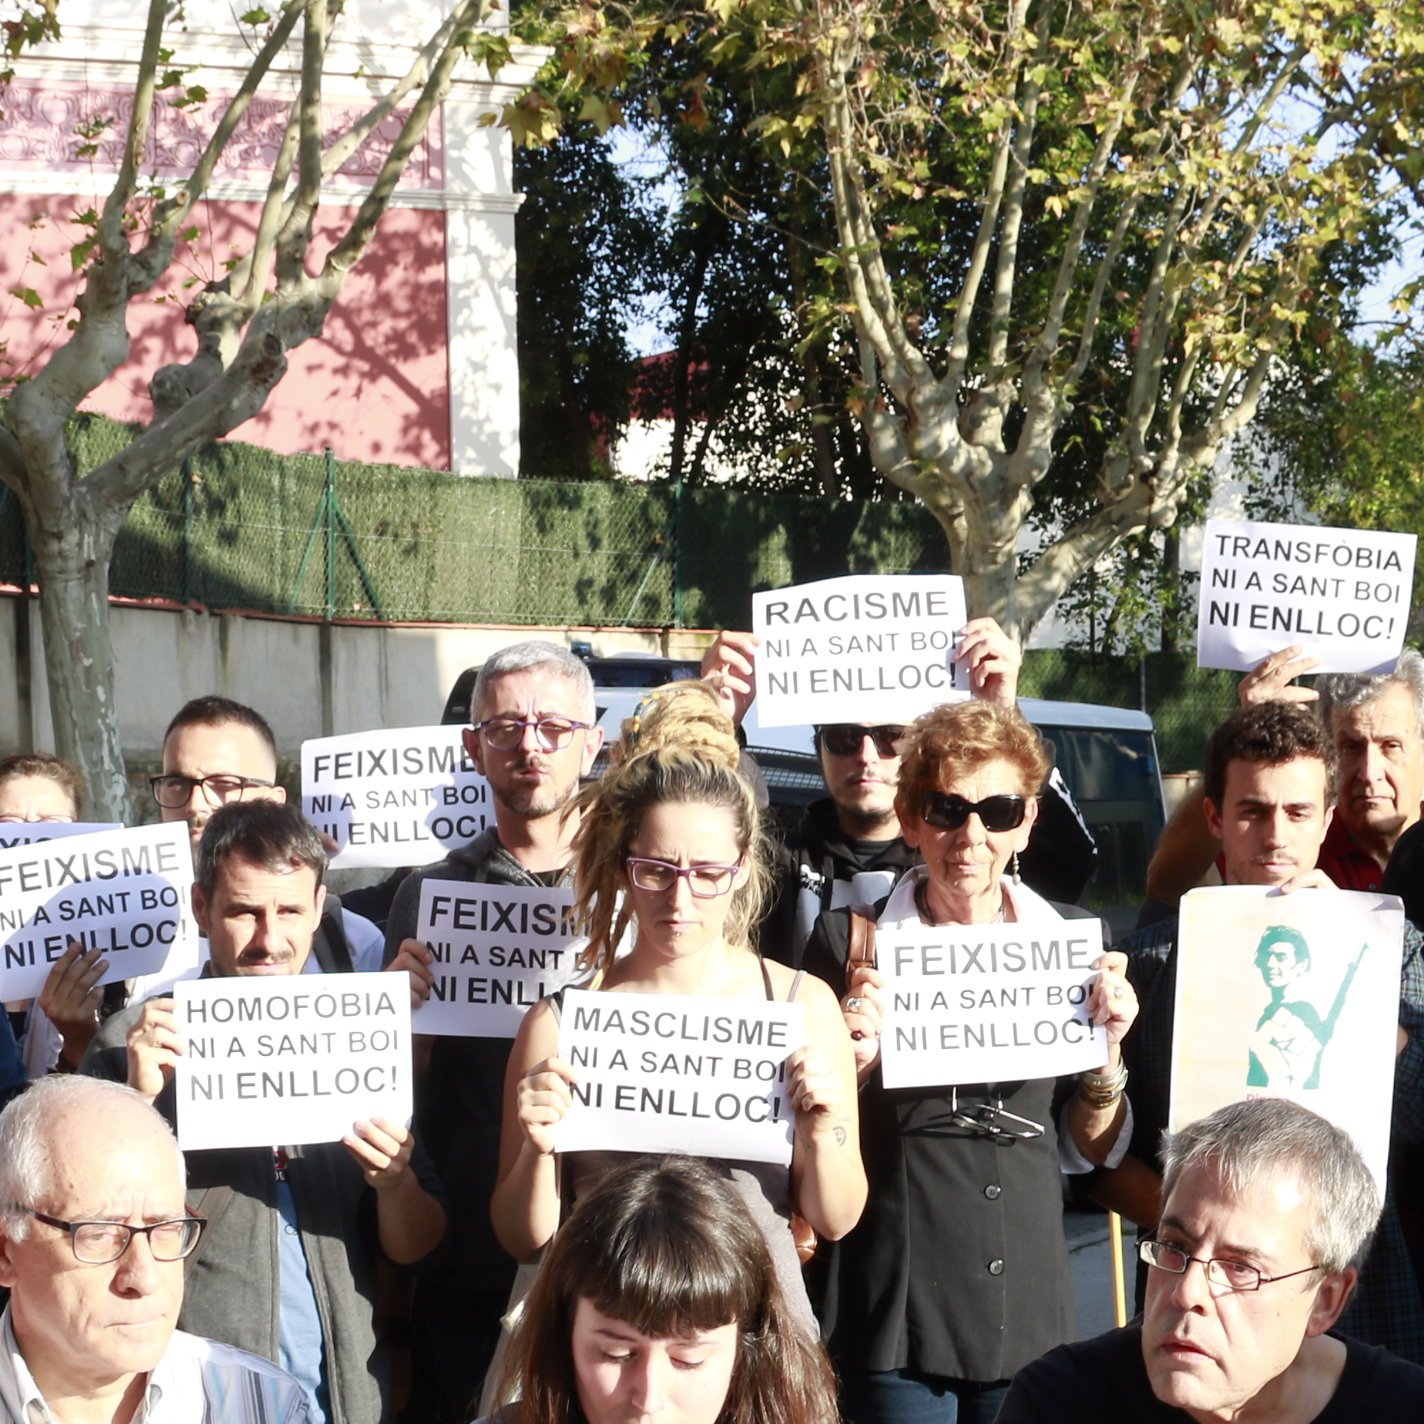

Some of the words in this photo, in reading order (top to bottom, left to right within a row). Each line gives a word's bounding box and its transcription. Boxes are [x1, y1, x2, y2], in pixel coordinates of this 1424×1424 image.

[1216, 535, 1402, 572] TRANSFÒBIA
[1212, 568, 1236, 589] NI
[1245, 571, 1262, 591] A
[1272, 573, 1345, 597] SANT
[1355, 581, 1400, 603] BOI
[766, 592, 948, 626] RACISME
[1210, 601, 1239, 627] NI
[1249, 604, 1394, 639] ENLLOC!
[766, 639, 790, 658] NI
[801, 638, 818, 656] A
[829, 633, 899, 655] SANT
[911, 631, 957, 650] BOI
[769, 671, 798, 695] NI
[810, 664, 956, 693] ENLLOC!
[312, 795, 332, 814] NI
[340, 793, 356, 811] A
[366, 788, 434, 809] SANT
[443, 785, 485, 805] BOI
[348, 815, 485, 845] ENLLOC!
[0, 909, 24, 931] NI
[33, 906, 51, 926] A
[59, 892, 131, 921] SANT
[140, 887, 185, 910] BOI
[894, 940, 1090, 976] FEIXISME
[187, 989, 395, 1023] HOMOFÒBIA
[895, 992, 919, 1011] NI
[930, 991, 948, 1010] A
[960, 987, 1035, 1009] SANT
[1047, 985, 1092, 1007] BOI
[189, 1038, 214, 1058] NI
[227, 1037, 245, 1057] A
[258, 1033, 336, 1056] SANT
[349, 1030, 397, 1052] BOI
[574, 1007, 787, 1047] MASCLISME
[896, 1026, 927, 1051] NI
[940, 1015, 1095, 1049] ENLLOC!
[571, 1046, 598, 1068] NI
[608, 1049, 628, 1071] A
[640, 1051, 723, 1077] SANT
[734, 1059, 785, 1083] BOI
[191, 1074, 223, 1101] NI
[237, 1066, 396, 1099] ENLLOC!
[615, 1085, 780, 1124] ENLLOC!
